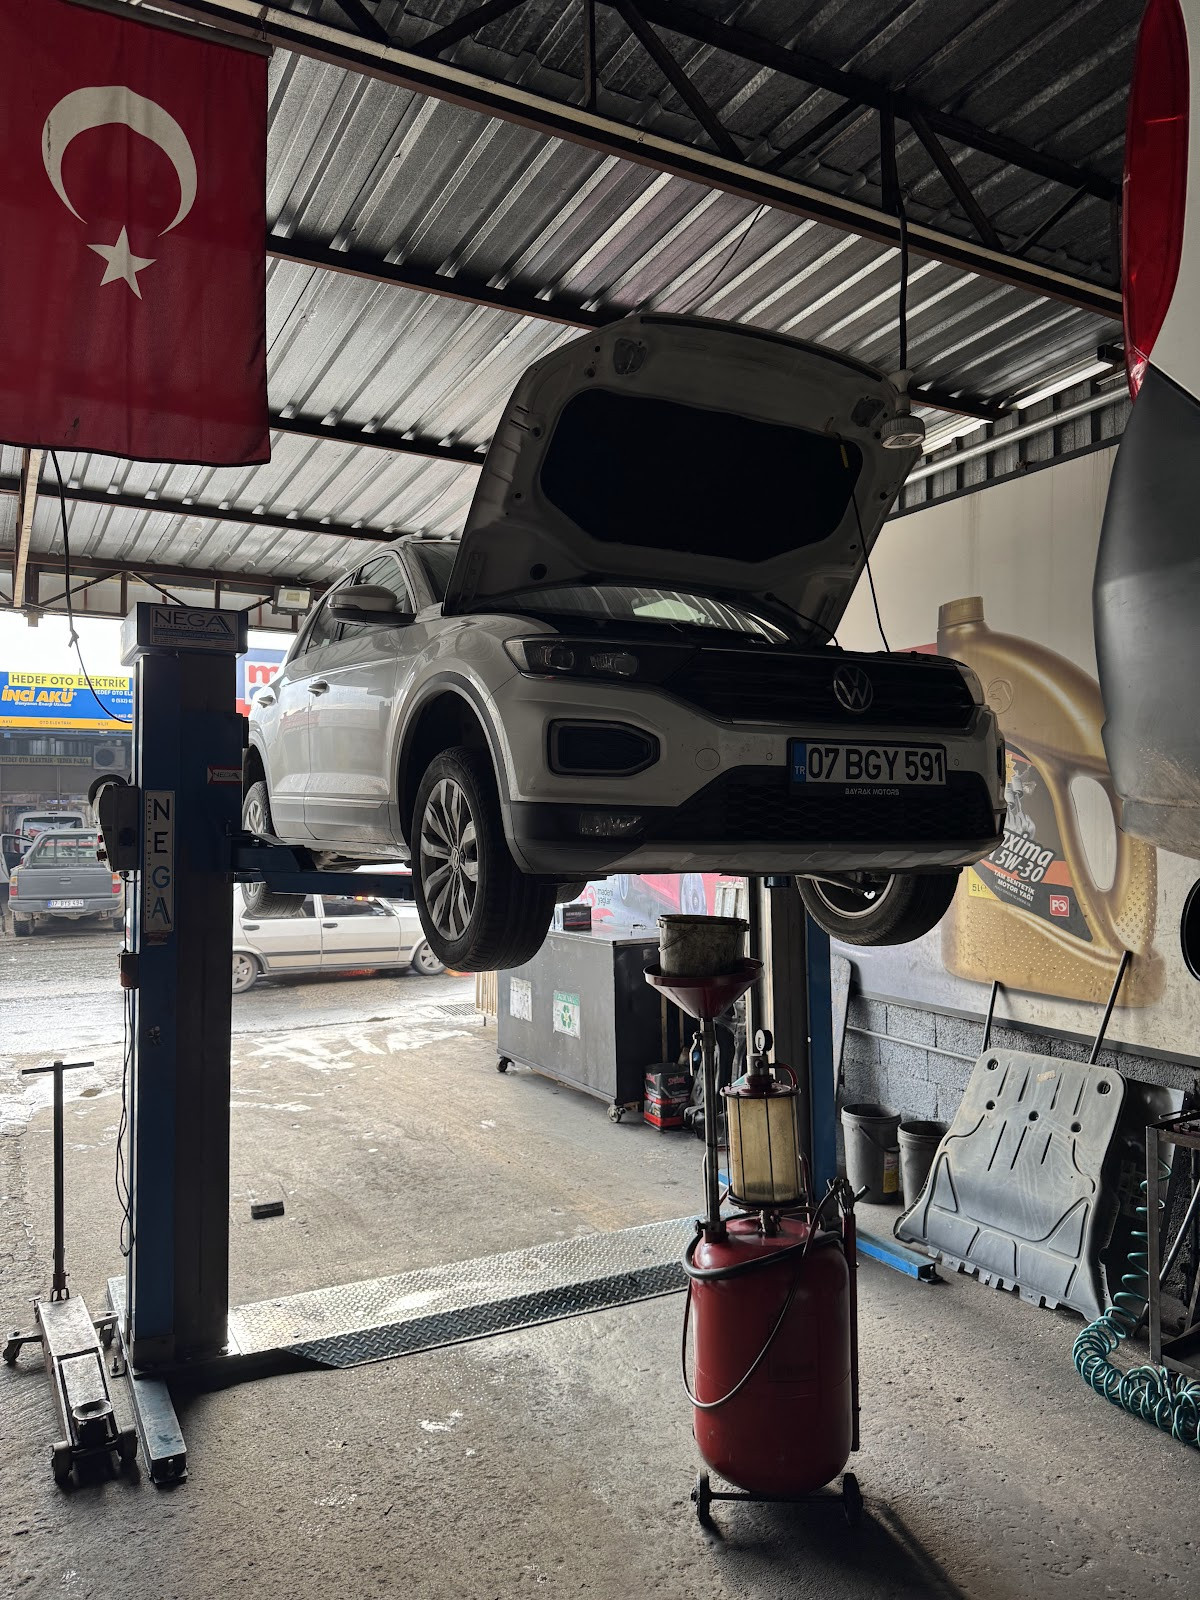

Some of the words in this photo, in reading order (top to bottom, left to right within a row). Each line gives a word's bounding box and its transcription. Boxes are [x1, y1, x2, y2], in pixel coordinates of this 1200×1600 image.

[155, 610, 233, 633] NEGA
[11, 674, 47, 684] HEDEF
[50, 676, 74, 686] OTO
[77, 677, 126, 688] ELEKTRİK
[1, 685, 35, 702] İNCİ
[36, 688, 74, 704] AKÜ
[794, 765, 806, 775] TR
[808, 747, 840, 779] 07
[845, 748, 899, 780] BGY
[904, 751, 944, 782] 591
[845, 787, 871, 795] BAYRAK
[872, 788, 900, 796] MOTORS
[152, 798, 171, 924] NEGA
[995, 849, 1044, 883] 5W-30
[994, 870, 1006, 880] TAM
[1006, 876, 1035, 895] SENTETİK
[997, 879, 1018, 894] MOTOR
